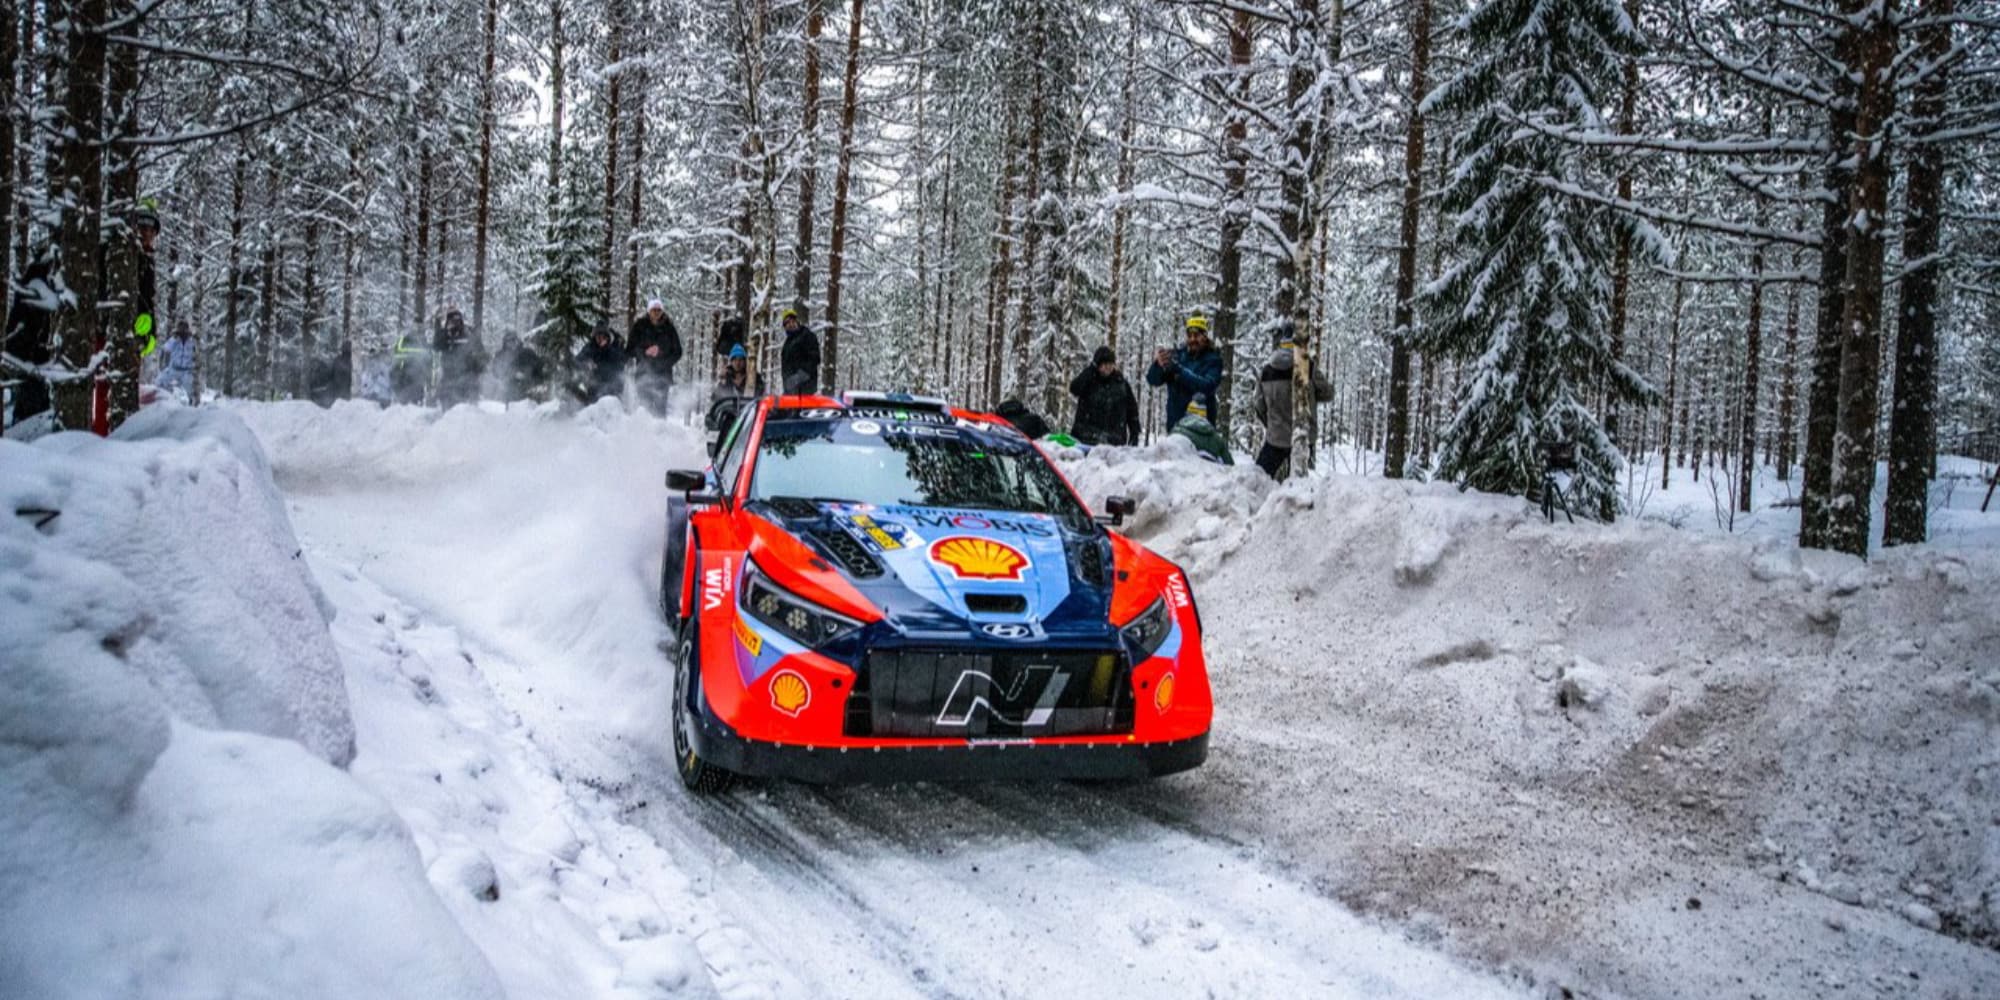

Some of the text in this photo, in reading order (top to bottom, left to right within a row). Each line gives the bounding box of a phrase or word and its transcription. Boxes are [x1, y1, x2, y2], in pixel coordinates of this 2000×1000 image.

[848, 408, 946, 424] HYUDAI
[886, 424, 960, 440] WRC
[912, 514, 1053, 538] MOBIS
